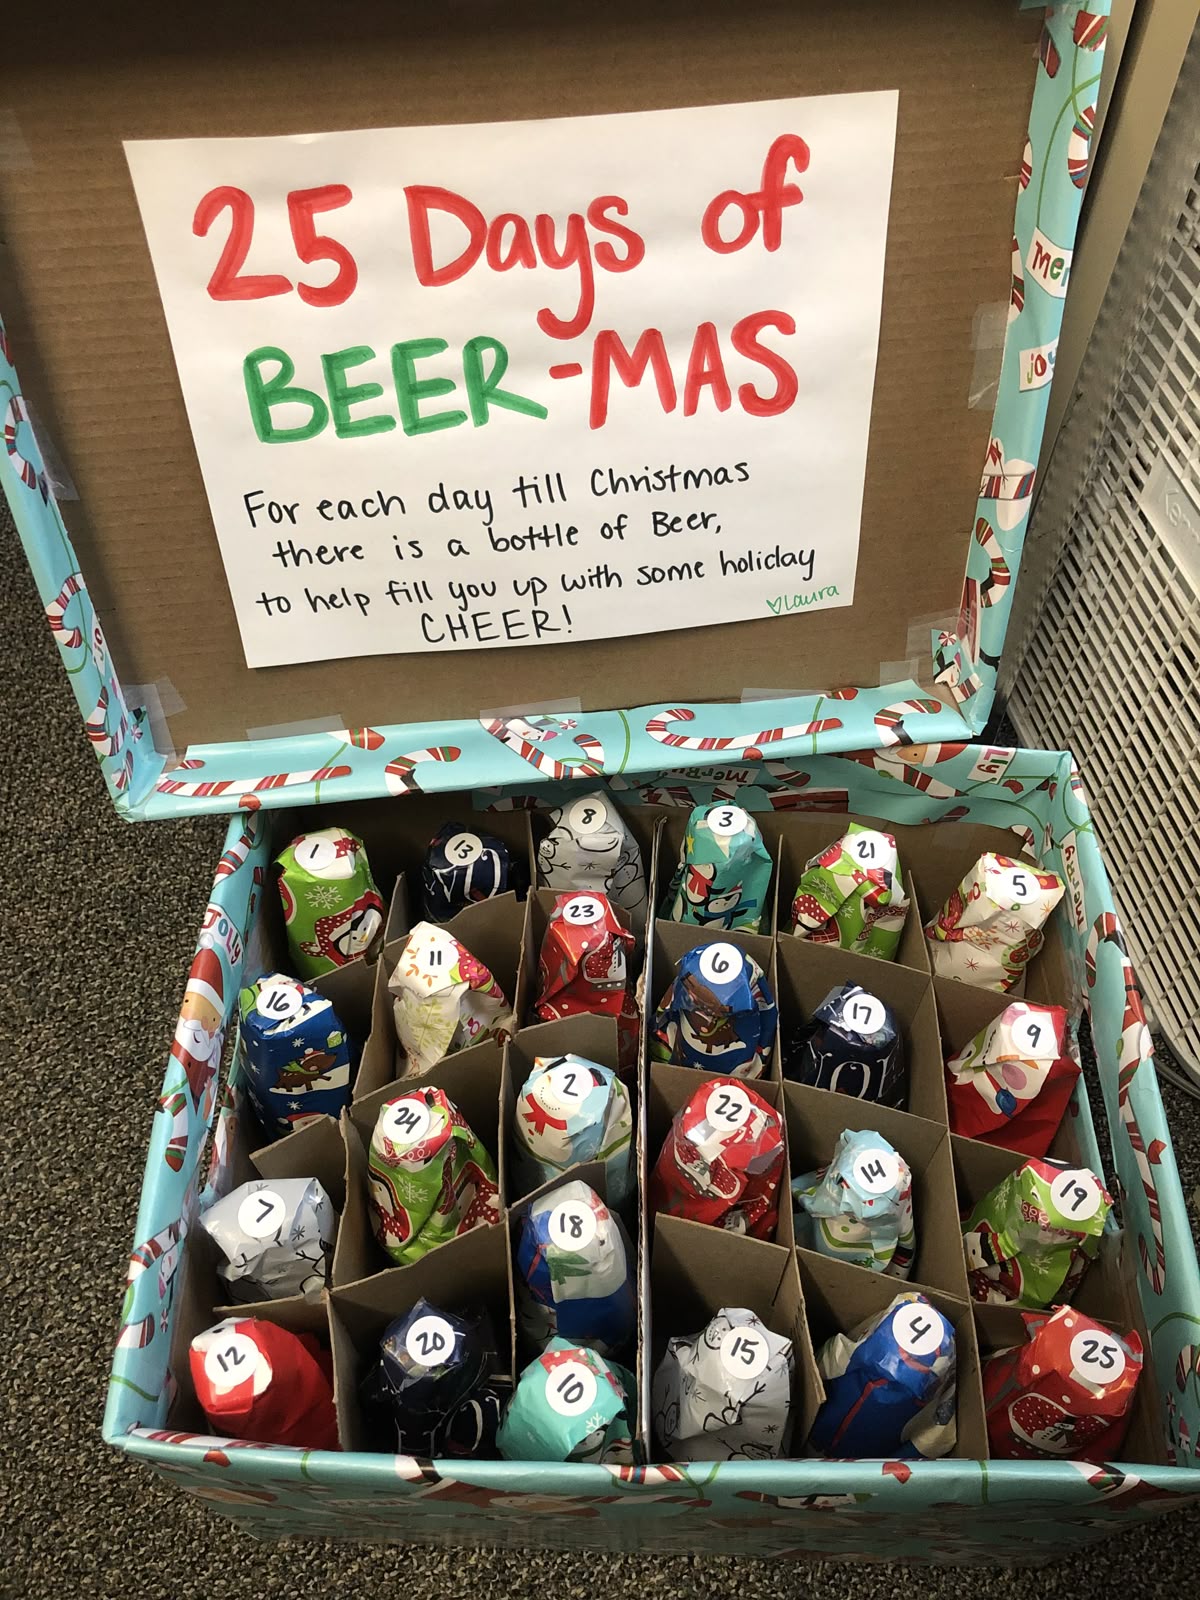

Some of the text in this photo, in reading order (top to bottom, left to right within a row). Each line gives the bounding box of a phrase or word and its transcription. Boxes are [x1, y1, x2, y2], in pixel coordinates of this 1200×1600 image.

[193, 134, 811, 340] 25 Days of
[244, 336, 548, 443] BEER
[244, 462, 749, 528] For each day till Christmas
[272, 510, 722, 567] there is a bottle of Beer,
[256, 545, 816, 617] to help fill you up with some holiday
[420, 604, 574, 645] CHEER!
[580, 807, 596, 824] 8
[717, 811, 733, 828] 3
[309, 844, 320, 859] 1
[454, 840, 474, 859] 13
[858, 840, 877, 859] 21
[1012, 875, 1027, 897] 5
[569, 904, 596, 918] 23
[429, 951, 442, 966] 11
[711, 952, 730, 973] 6
[266, 991, 291, 1012] 16
[853, 1003, 872, 1025] 17
[1026, 1023, 1042, 1048] 9
[562, 1073, 579, 1097] 2
[393, 1107, 422, 1135] 24
[714, 1094, 743, 1123] 22
[860, 1159, 887, 1184] 14
[1059, 1179, 1088, 1212] 19
[256, 1198, 275, 1223] 7
[559, 1212, 584, 1239] 18
[909, 1316, 932, 1345] 4
[415, 1331, 446, 1356] 20
[730, 1336, 760, 1365] 15
[1081, 1339, 1118, 1370] 25
[216, 1346, 246, 1373] 12
[556, 1373, 584, 1404] 10
